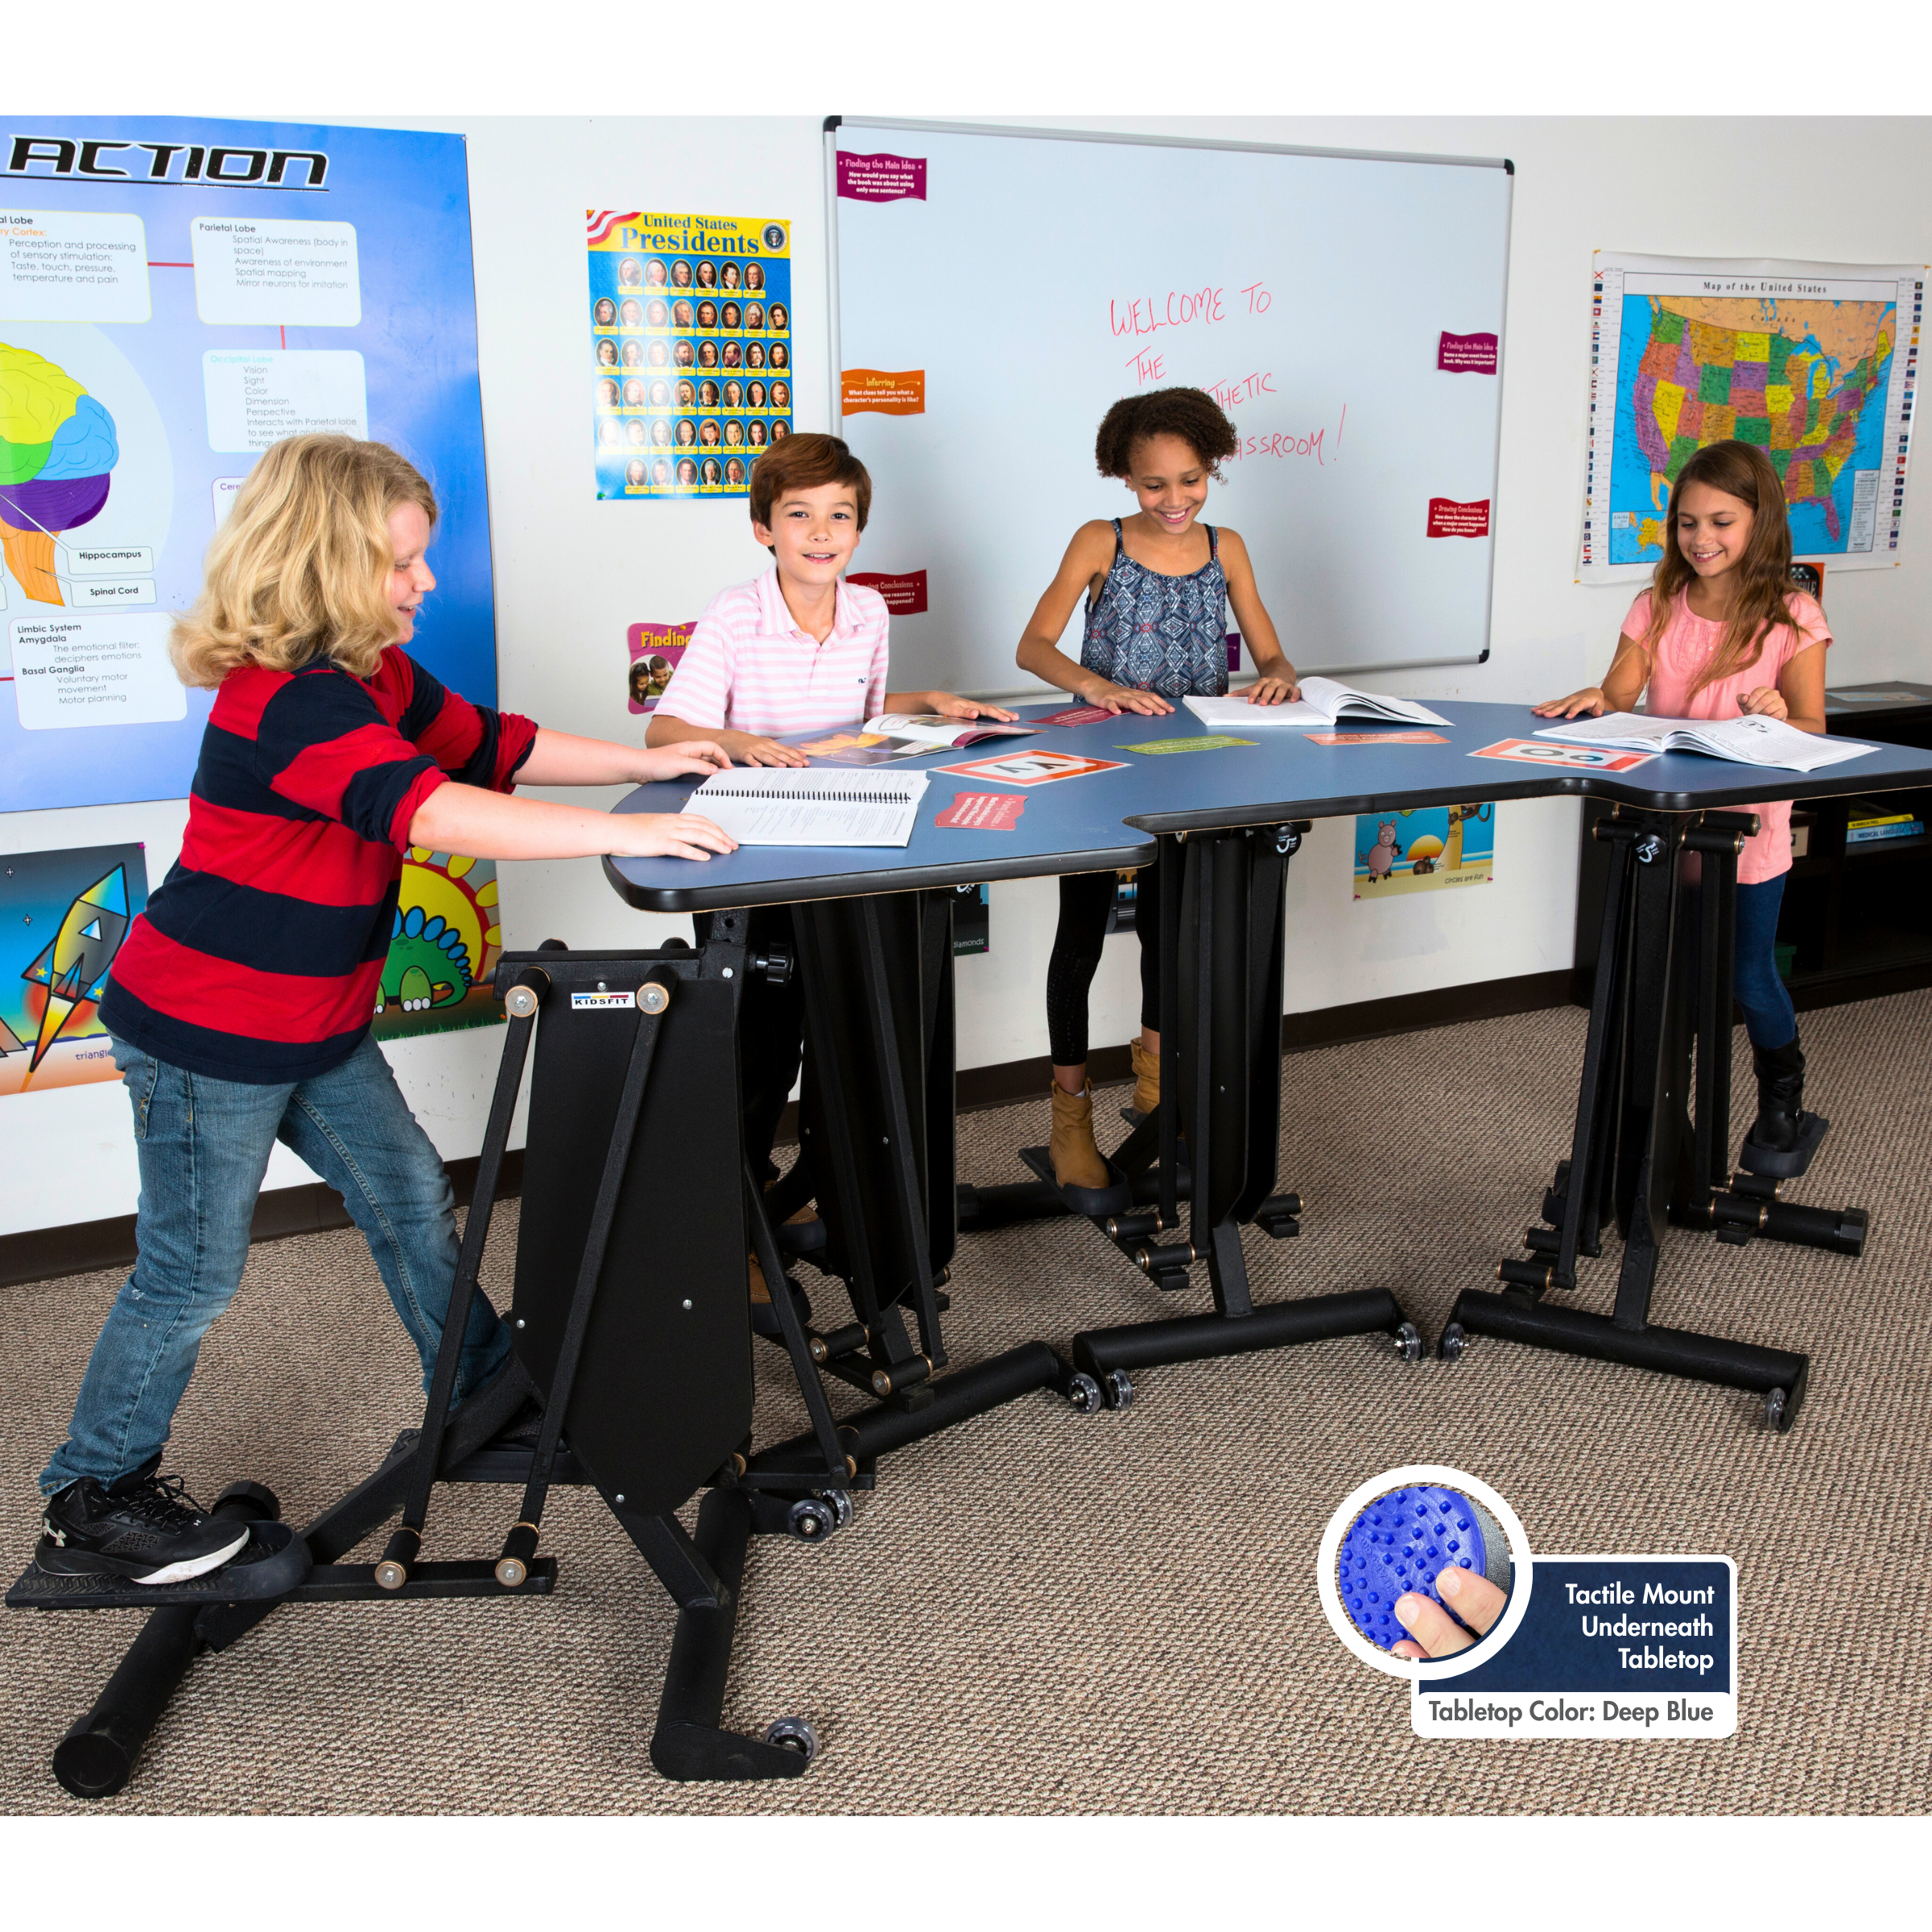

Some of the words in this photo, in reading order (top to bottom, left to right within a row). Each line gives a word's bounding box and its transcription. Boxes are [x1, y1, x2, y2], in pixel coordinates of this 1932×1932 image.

[8, 135, 329, 188] ACTION
[845, 159, 870, 171] Finding
[872, 159, 883, 168] the
[886, 160, 899, 169] Main
[902, 160, 915, 170] Idea
[10, 216, 33, 224] Lobe
[644, 214, 691, 228] United
[696, 217, 737, 230] States
[11, 227, 47, 236] Cortex:
[200, 223, 233, 231] Parietal
[9, 238, 62, 249] Perception
[85, 242, 136, 252] processing
[232, 234, 262, 244] Spatial
[265, 237, 312, 245] Awareness
[313, 237, 339, 247] (body
[620, 227, 759, 254] Presidents
[10, 250, 20, 258] of
[23, 252, 58, 261] sensory
[60, 252, 113, 261] stimulation:
[233, 246, 264, 256] space)
[11, 261, 39, 270] Taste,
[41, 262, 72, 271] touch,
[235, 257, 282, 266] Awareness
[295, 258, 348, 267] environment
[235, 267, 266, 277] Spatial
[266, 269, 307, 279] mapping
[13, 273, 73, 283] temperature
[75, 275, 95, 283] and
[97, 275, 118, 284] pain
[237, 279, 261, 287] Mirror
[298, 279, 310, 287] for
[312, 280, 348, 288] imitation
[1703, 283, 1721, 291] Map
[1761, 283, 1792, 291] United
[1798, 284, 1827, 293] States
[1111, 287, 1225, 336] WELCOME
[1241, 282, 1271, 314] TO
[210, 355, 250, 364] Occipital
[243, 365, 268, 374] Vision
[1125, 345, 1166, 386] THE
[243, 376, 265, 386] Sight
[867, 378, 895, 388] Inferring
[245, 386, 268, 394] Color
[245, 397, 290, 405] Dimension
[246, 407, 296, 416] Perspective
[338, 418, 357, 427] lobe
[79, 551, 142, 560] Hippocampus
[881, 580, 913, 589] Conclusions
[89, 588, 116, 597] Spinal
[17, 625, 47, 633] Limbic
[49, 624, 81, 633] System
[19, 634, 67, 644] Amygdala
[71, 642, 117, 651] emotional
[54, 654, 99, 663] deciphers
[101, 652, 142, 660] emotions
[22, 667, 47, 675] Basal
[48, 665, 85, 674] Ganglia
[56, 675, 100, 683] Voluntary
[57, 684, 106, 693] movement
[87, 694, 127, 704] planning
[1880, 828, 1905, 836] LANGUAGE
